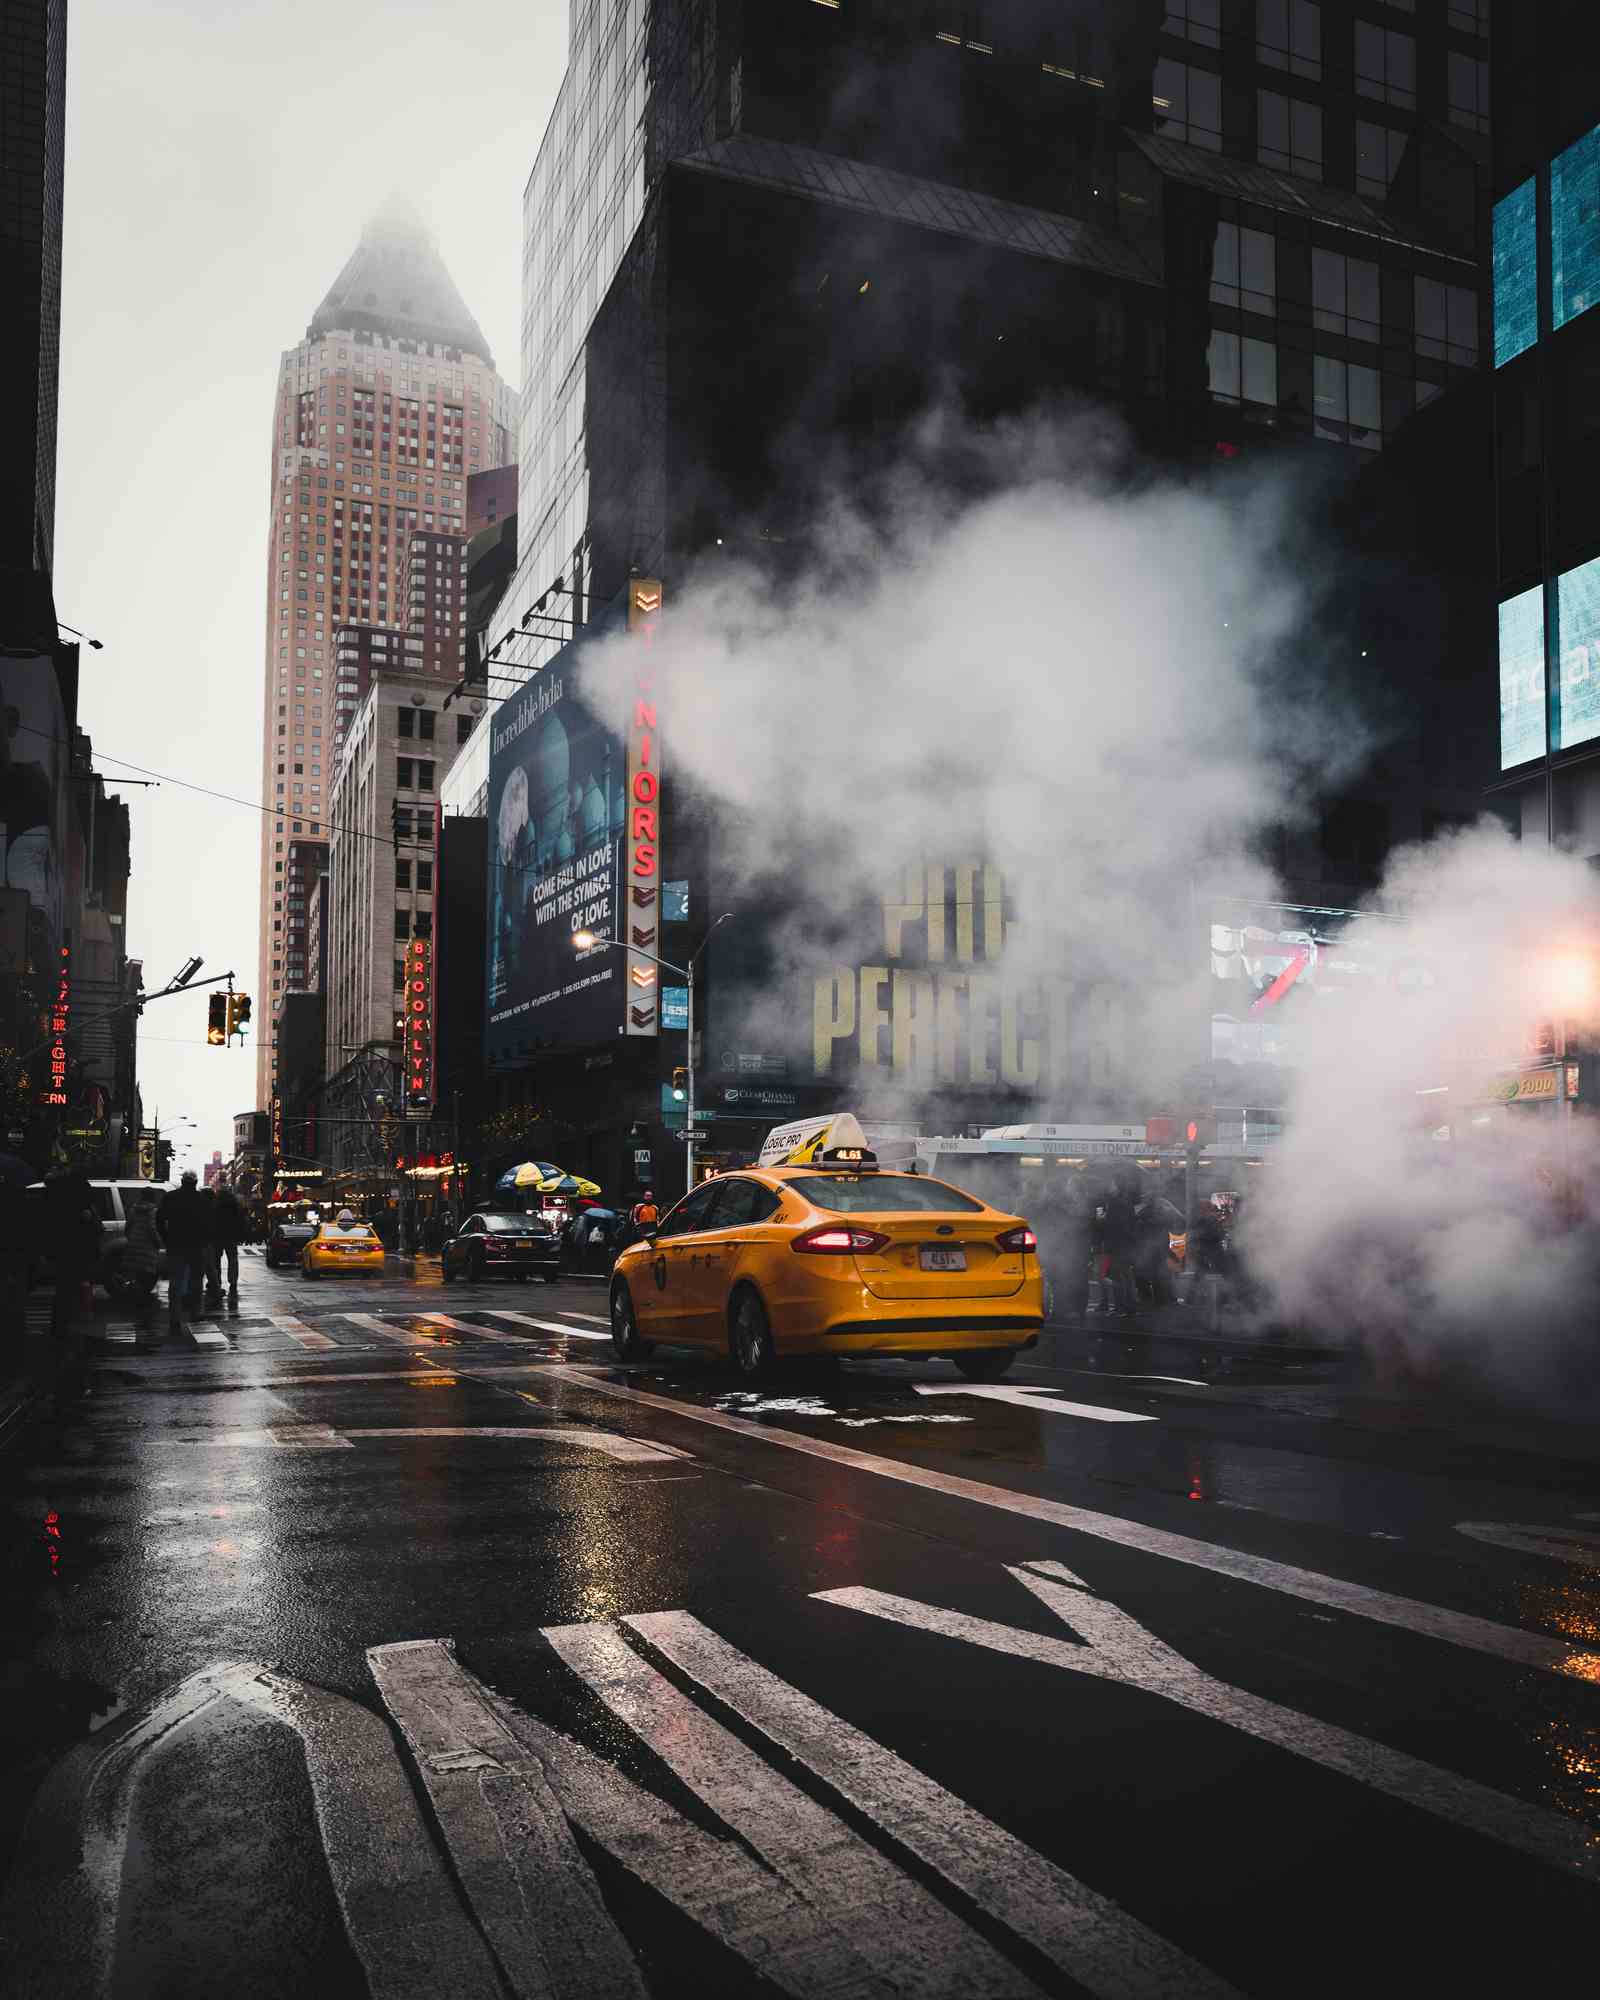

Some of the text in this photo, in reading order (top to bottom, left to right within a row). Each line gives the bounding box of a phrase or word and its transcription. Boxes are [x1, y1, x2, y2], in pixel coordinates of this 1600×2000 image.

[533, 843, 612, 904] COME FALL IN LOVE
[536, 870, 612, 926] WITH THE SYMBOL
[571, 897, 612, 932] OF LOVE.
[412, 942, 425, 1089] BROOKLYN
[763, 1133, 802, 1150] LOGIC PRO
[836, 1150, 862, 1160] 4L61
